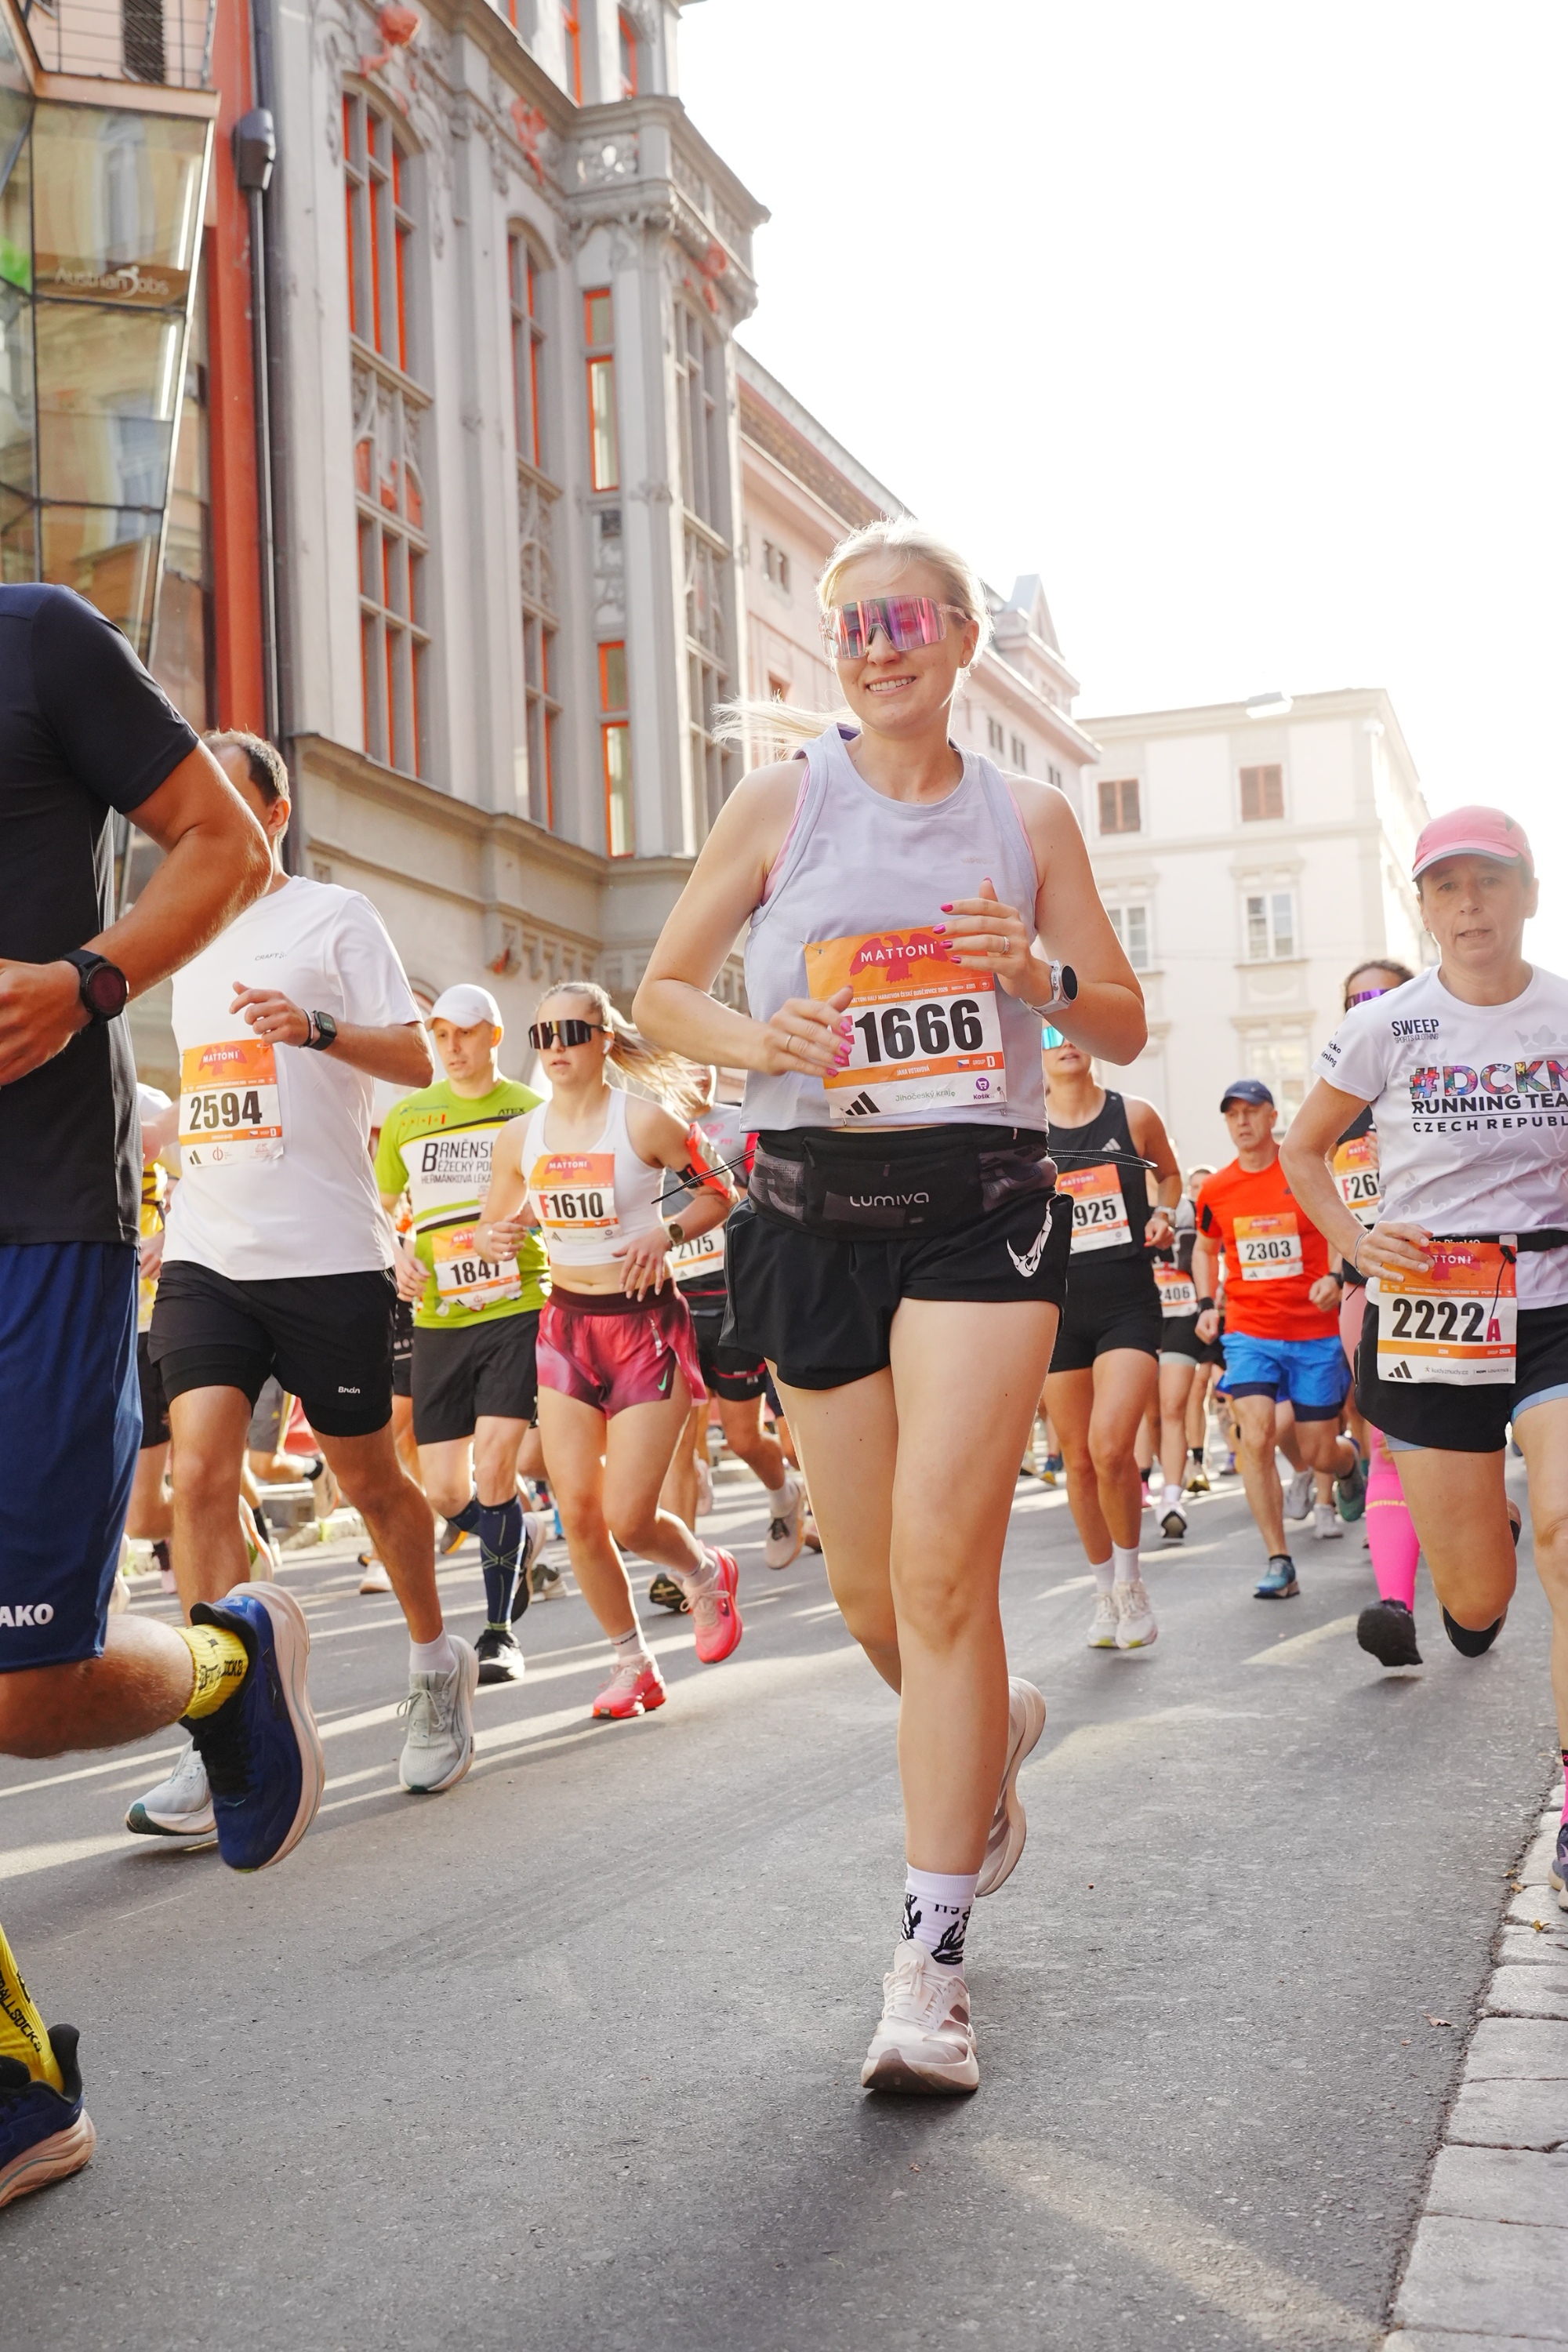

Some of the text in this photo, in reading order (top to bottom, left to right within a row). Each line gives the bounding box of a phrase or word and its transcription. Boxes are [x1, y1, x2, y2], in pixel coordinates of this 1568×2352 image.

[860, 943, 935, 963] MATTONI
[1391, 1018, 1439, 1036] SWEEP
[1394, 1033, 1439, 1044] SPORTS CLOTHING
[202, 1051, 238, 1063] MATTONI
[986, 1055, 996, 1068] D
[896, 1068, 908, 1076] JANA
[895, 1090, 935, 1102] Jihočeský
[190, 1091, 263, 1131] 2594
[1412, 1094, 1521, 1114] RUNNING
[1413, 1120, 1478, 1133] CZECH
[549, 1160, 587, 1169] MATTONI
[539, 1192, 604, 1218] F1610
[1072, 1199, 1116, 1228] 925
[1247, 1240, 1291, 1261] 2303
[1432, 1254, 1472, 1265] TTONI
[0, 1603, 54, 1628] AKO
